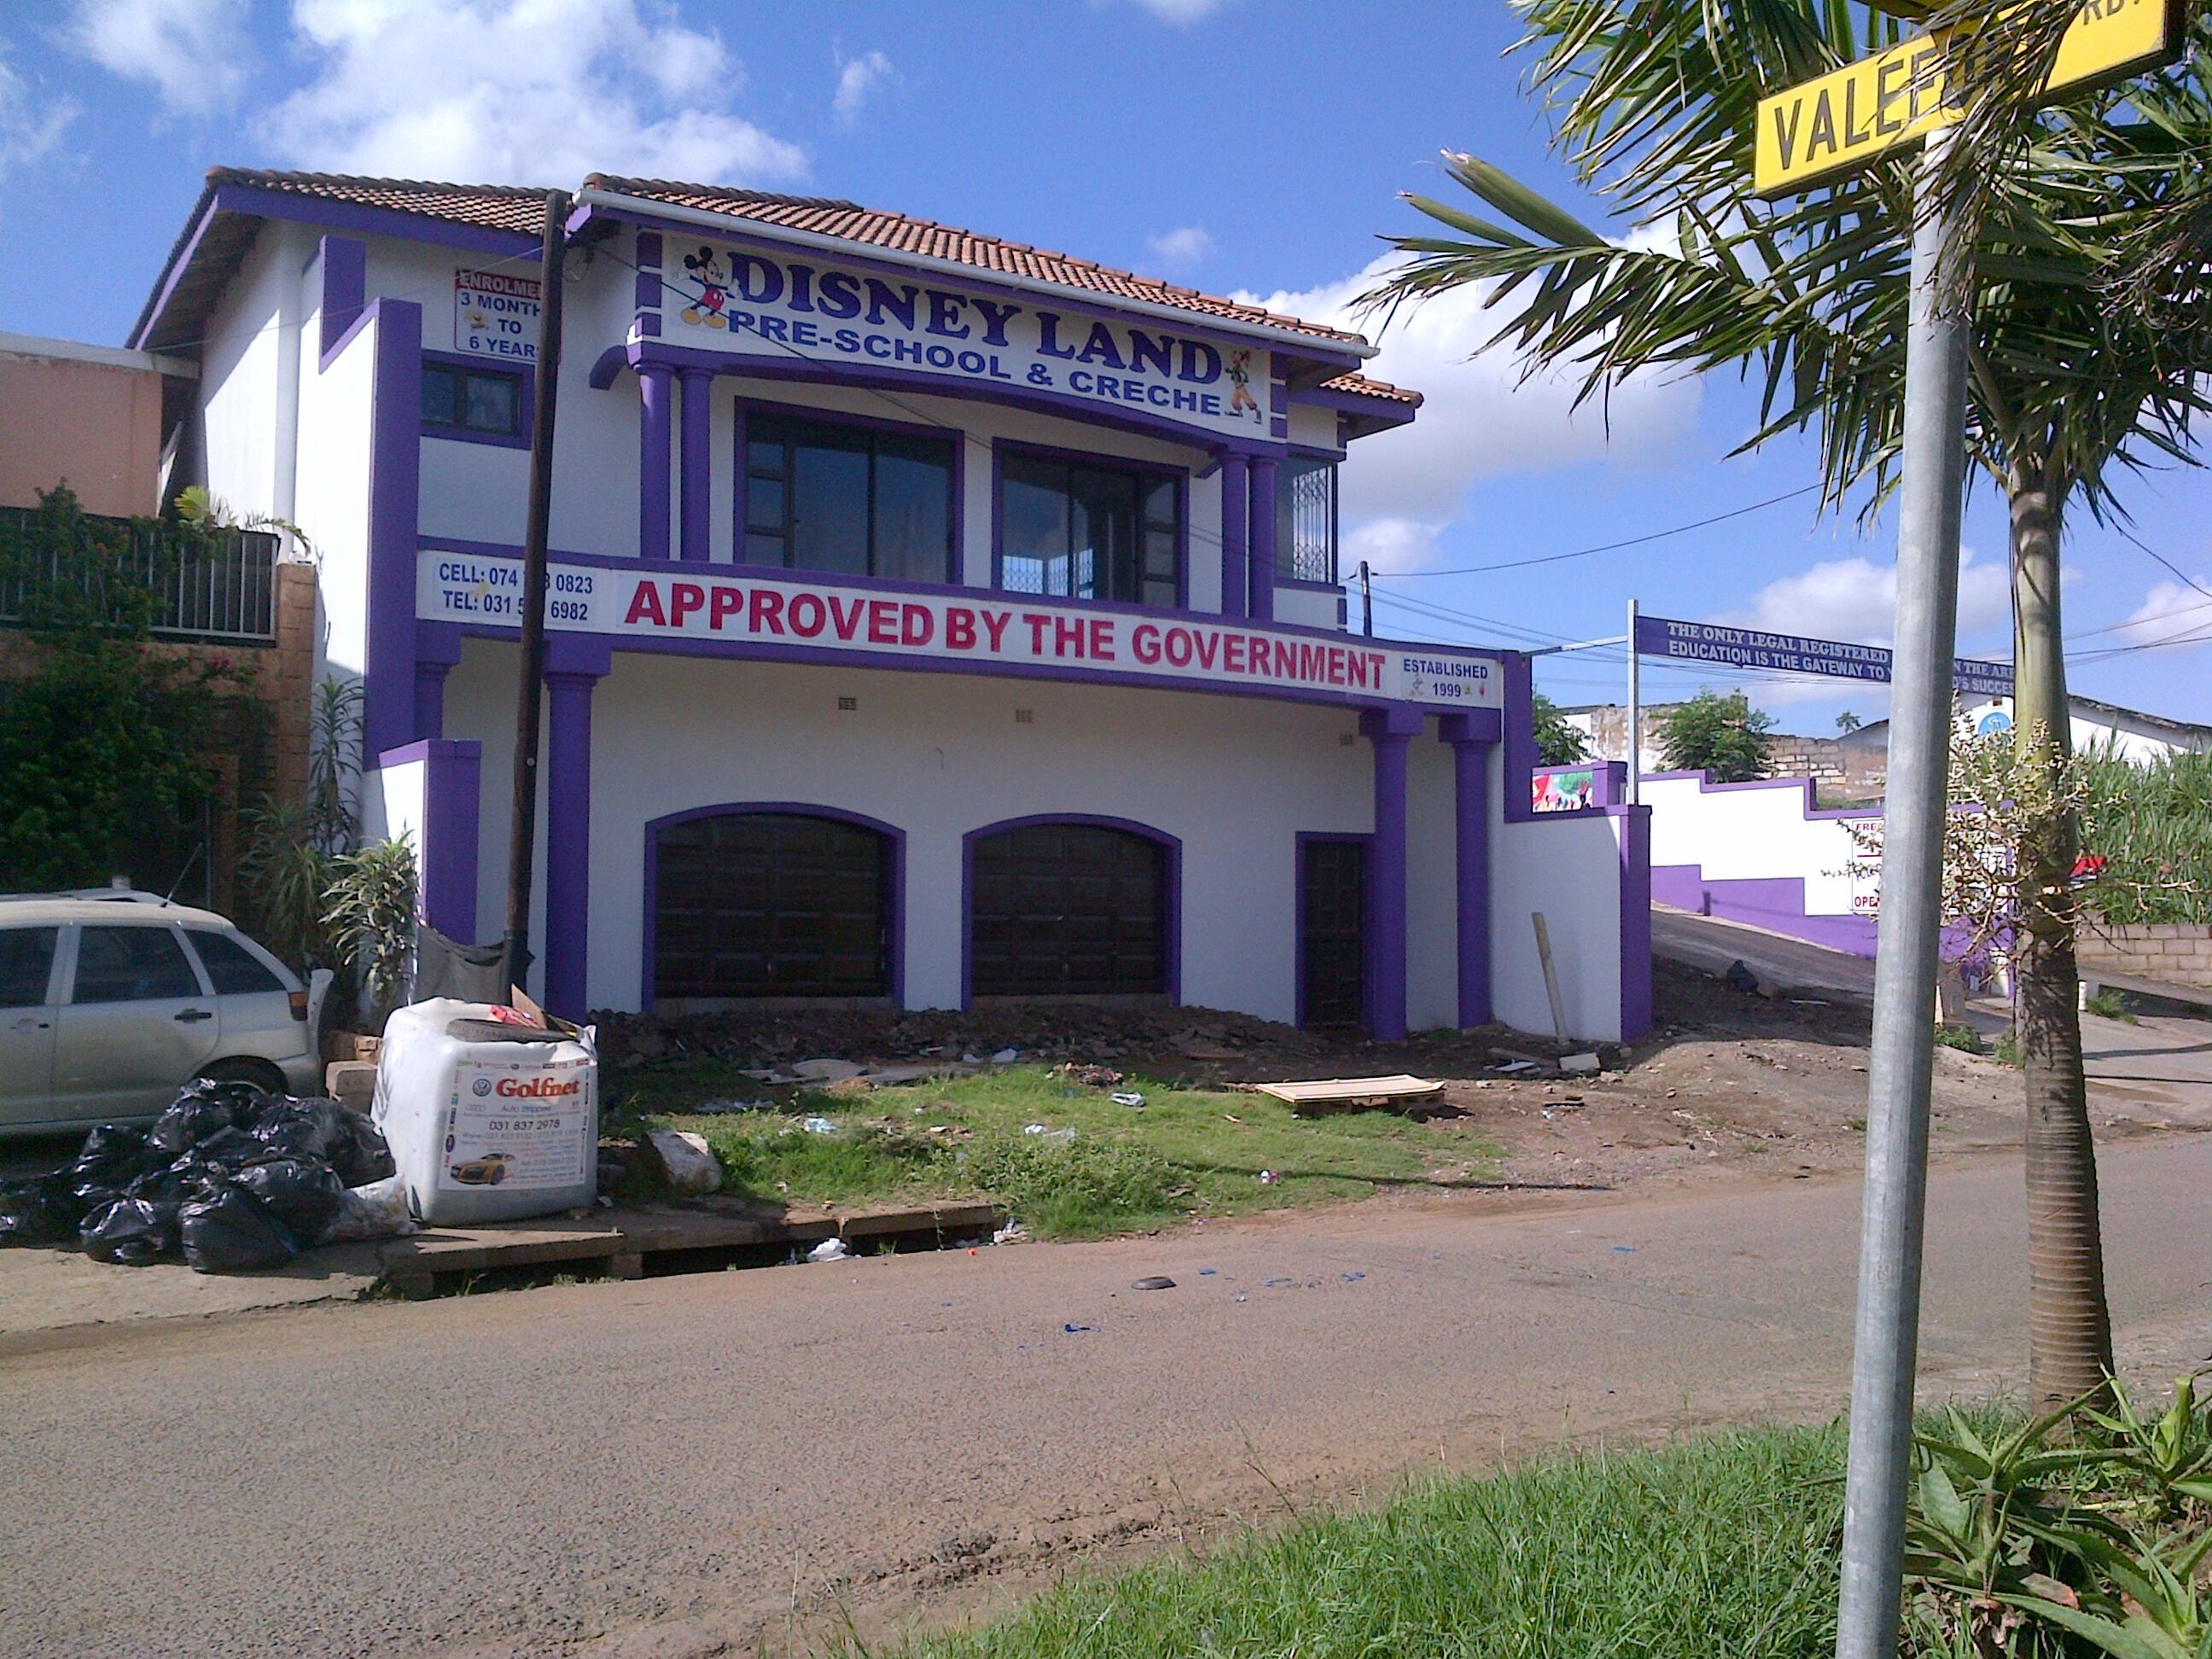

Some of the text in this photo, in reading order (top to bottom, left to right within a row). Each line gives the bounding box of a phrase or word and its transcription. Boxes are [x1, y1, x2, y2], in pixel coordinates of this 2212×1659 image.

[459, 272, 541, 299] ENROLME
[461, 292, 471, 306] 3
[498, 318, 522, 334] TO
[469, 336, 539, 358] 6 YEAR
[729, 309, 1221, 416] PRE-SCHOOL & CRECHE
[439, 562, 485, 583] CELL:
[489, 568, 518, 587] 074
[556, 573, 593, 594] 0823
[443, 590, 478, 611] TEL:
[484, 594, 511, 614] 031
[550, 601, 588, 620] 6982
[624, 580, 1386, 690] APPROVED BY THE GOVERNMENT
[1667, 621, 1701, 639] THE
[1703, 626, 1745, 645] ONLY
[1749, 632, 1797, 651] LEGAL
[1799, 639, 1889, 663] REGISTERED
[1964, 661, 1989, 677] THE
[1668, 640, 1751, 664] EDUCATION
[1755, 650, 1769, 666] IS
[1772, 653, 1799, 669] THE
[1802, 656, 1863, 677] GATEWAY
[1867, 664, 1885, 680] TO
[1403, 658, 1488, 679] ESTABLISHED
[1434, 682, 1461, 697] 1999
[496, 1076, 580, 1097] Golfnet
